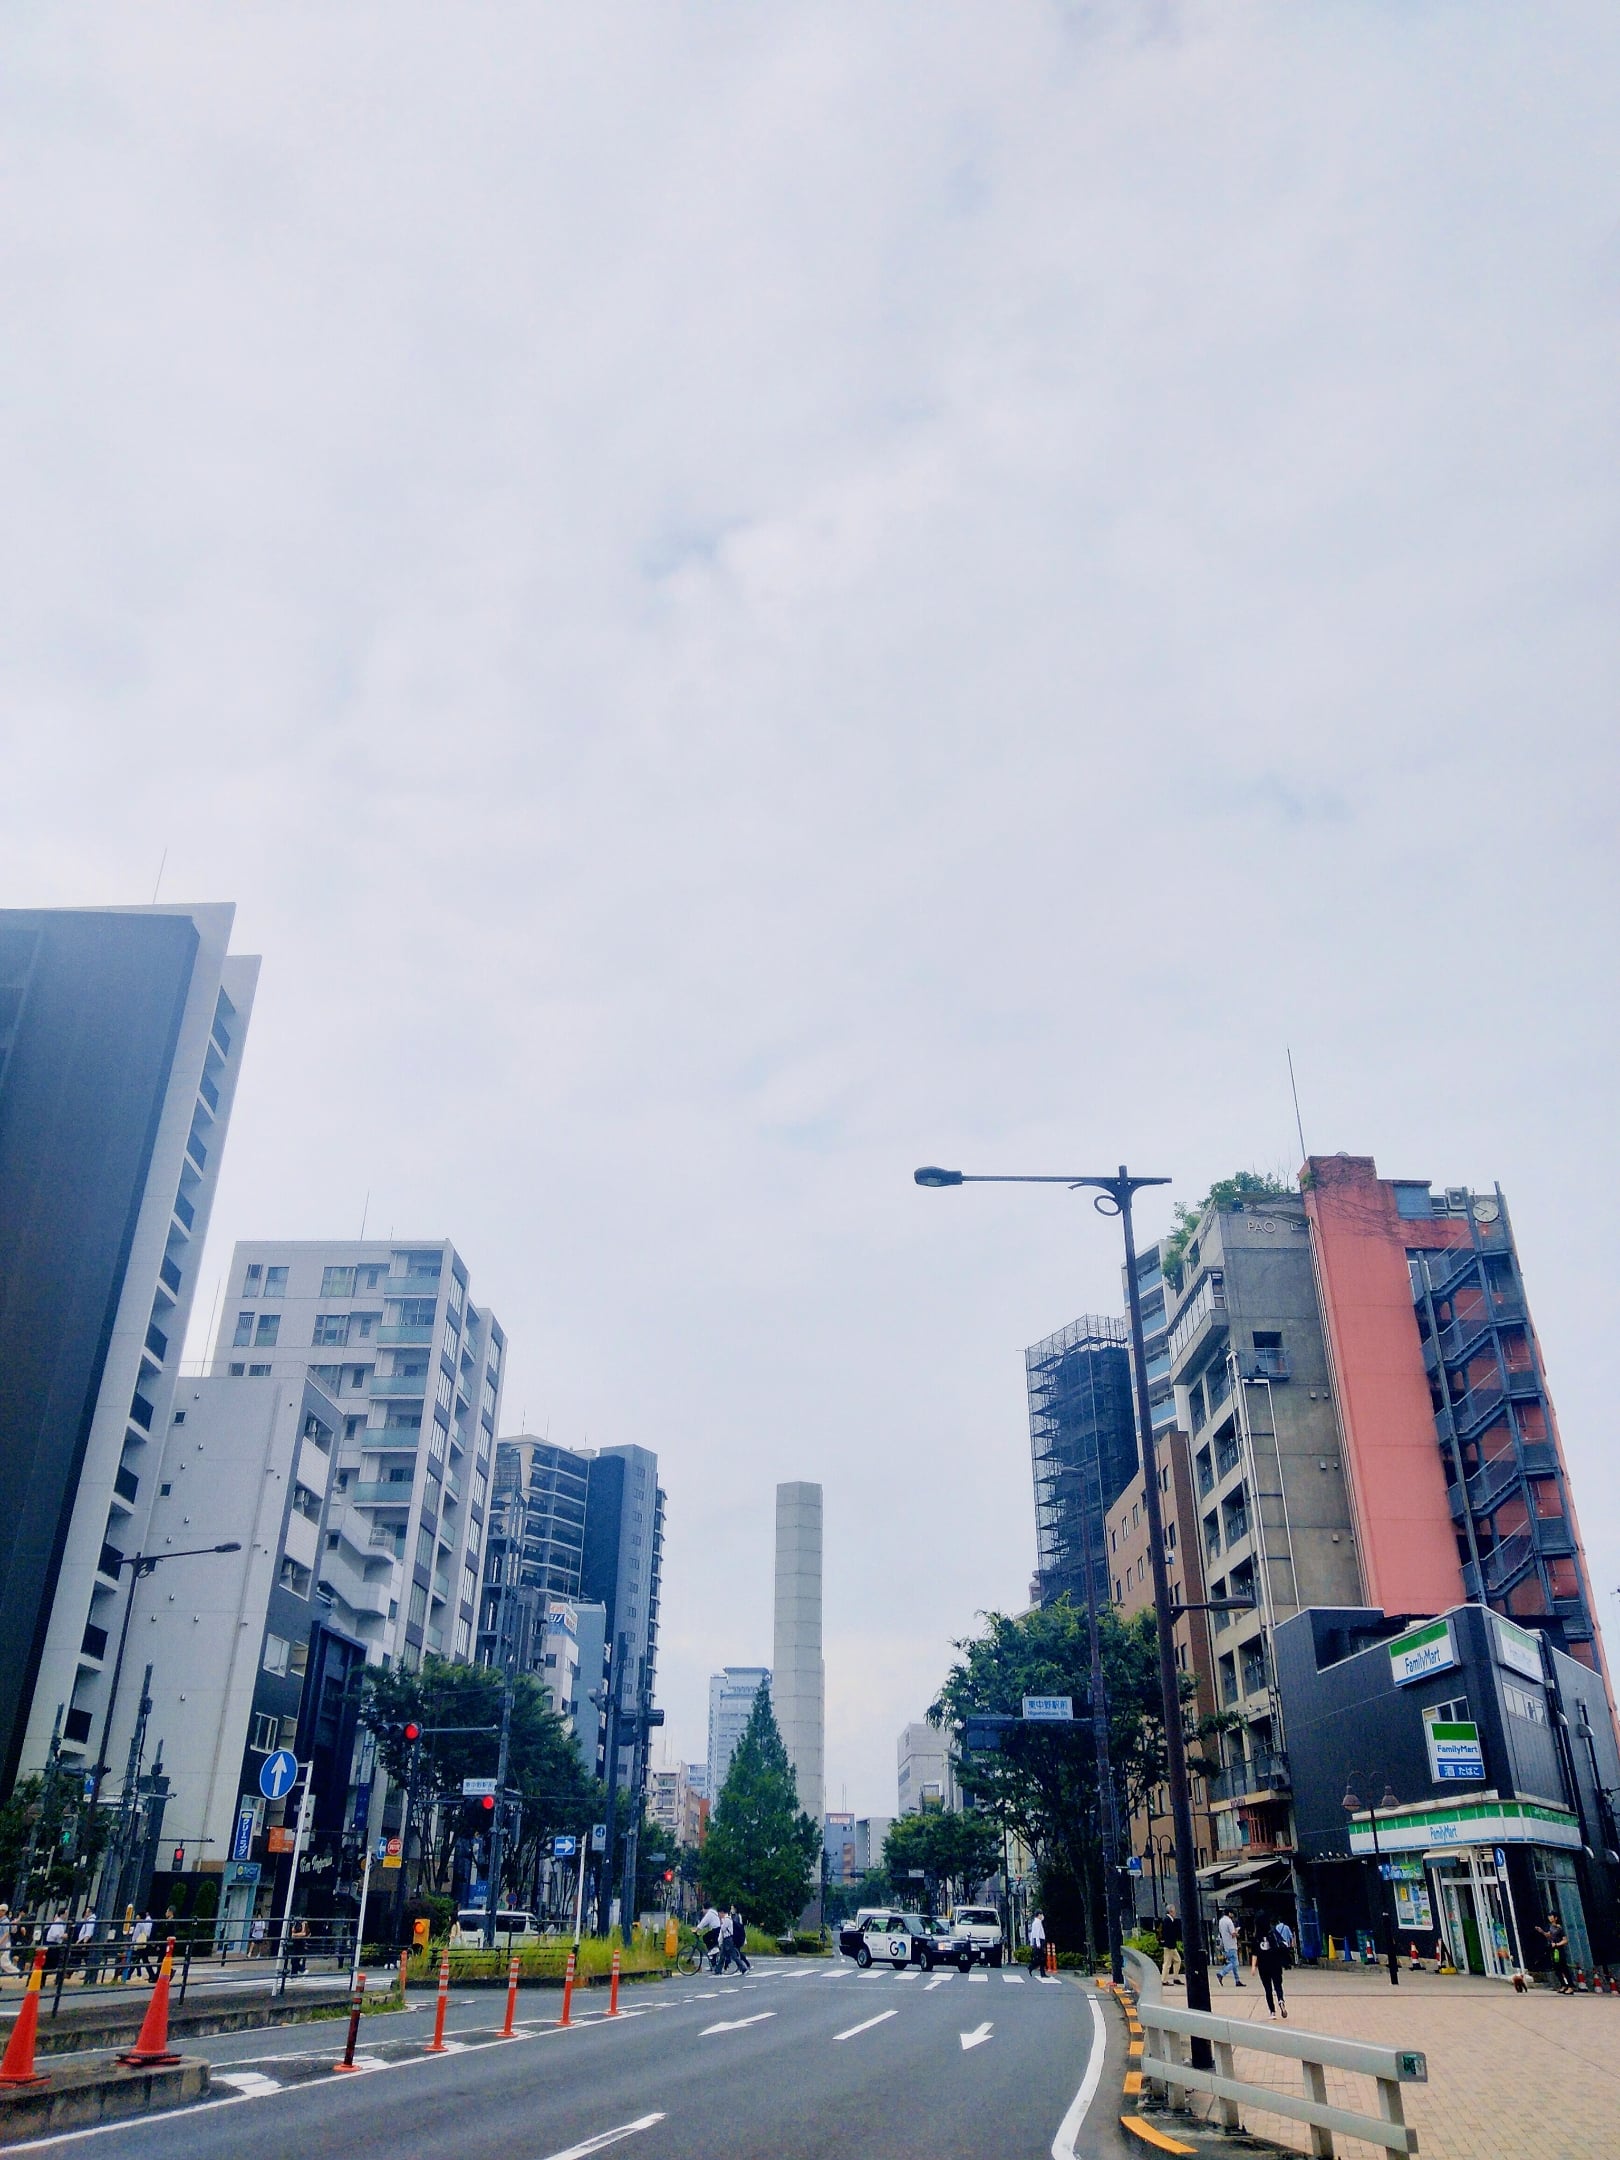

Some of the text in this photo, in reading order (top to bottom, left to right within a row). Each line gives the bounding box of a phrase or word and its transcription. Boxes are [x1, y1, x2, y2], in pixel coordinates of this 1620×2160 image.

[1247, 1221, 1276, 1233] PAO
[1405, 1646, 1440, 1674] FamilyMart
[1437, 1745, 1478, 1755] FamilyMart
[1430, 1825, 1458, 1841] FamilyMart
[890, 1941, 906, 1958] GO
